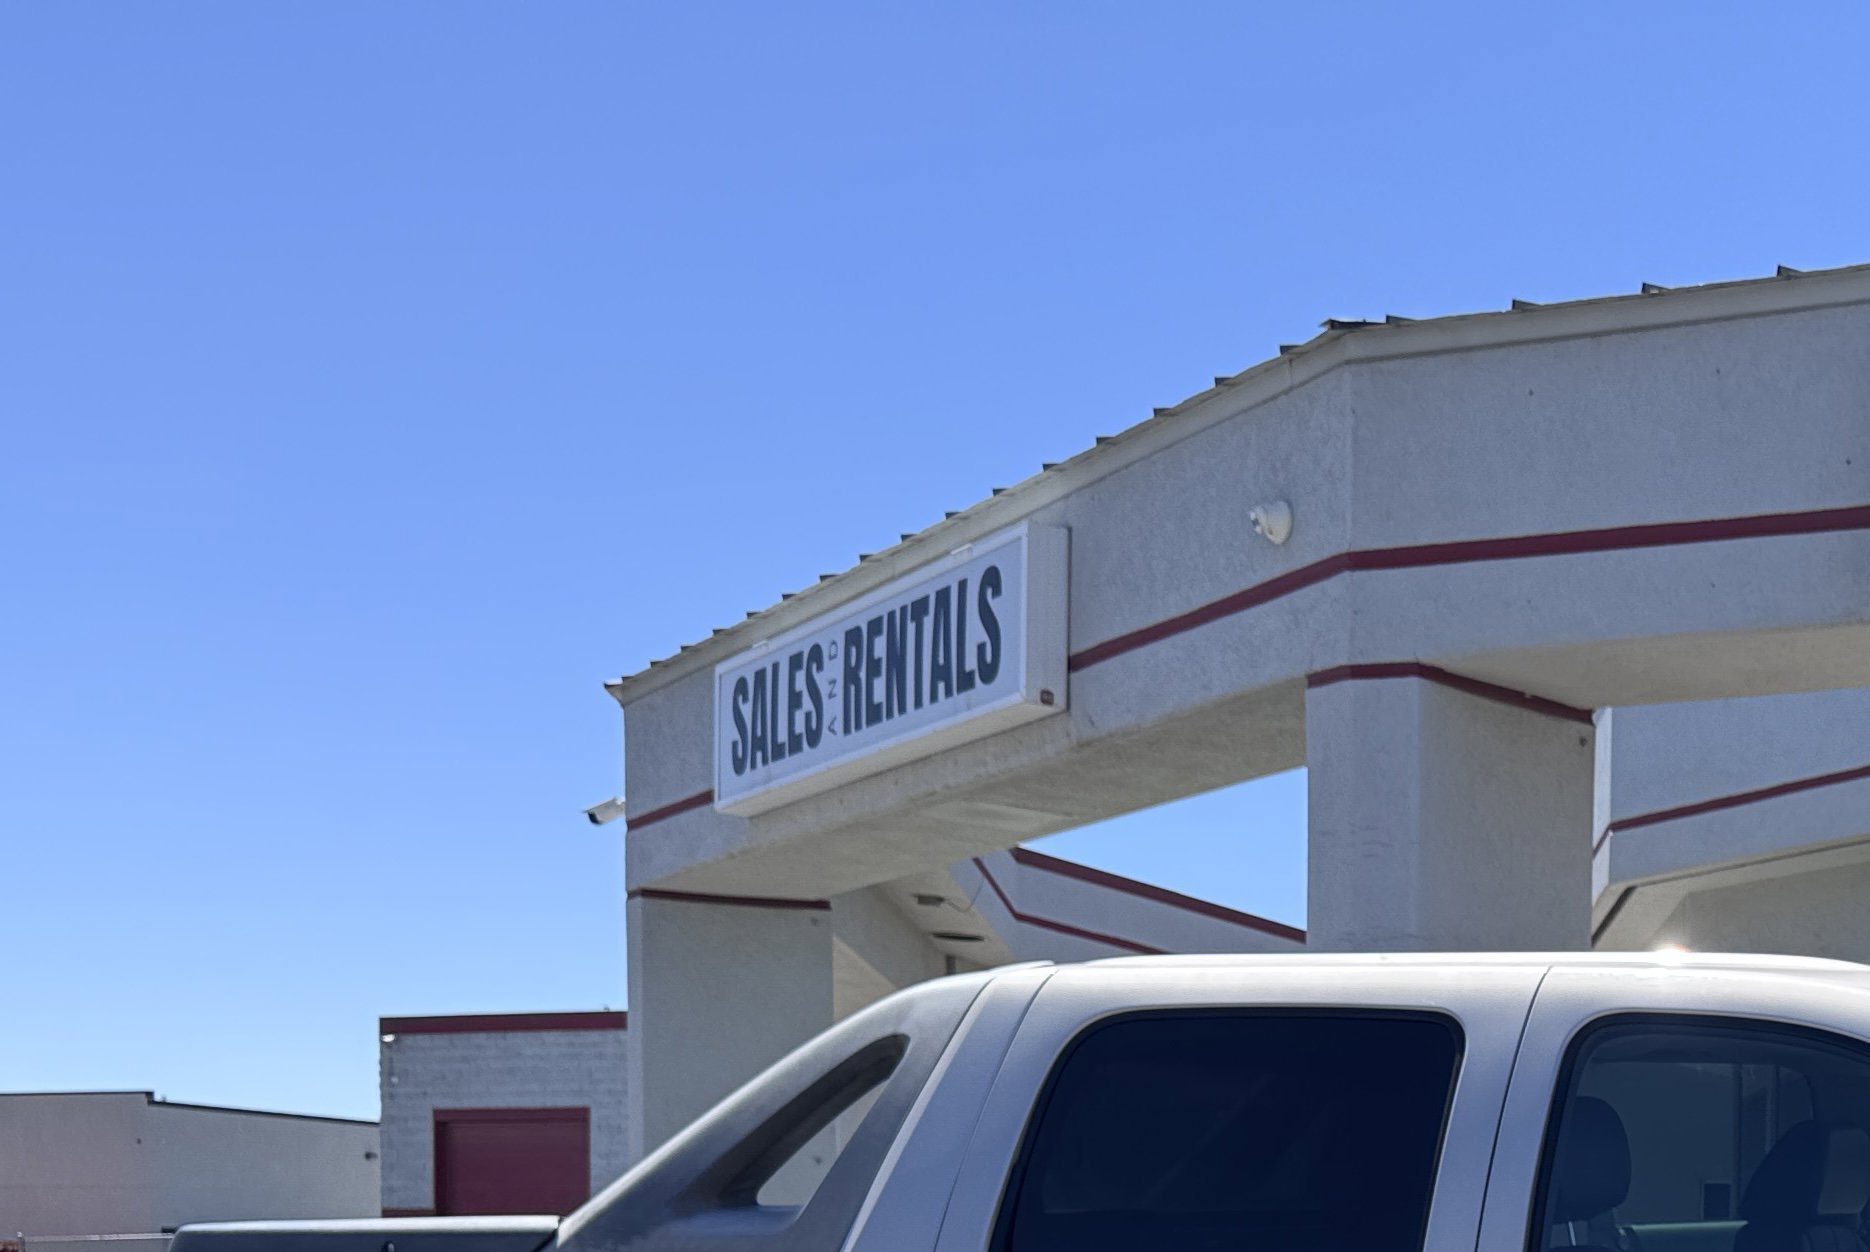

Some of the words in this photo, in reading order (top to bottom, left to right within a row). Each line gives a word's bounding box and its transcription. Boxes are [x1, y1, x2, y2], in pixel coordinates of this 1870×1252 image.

[731, 643, 824, 776] SALES
[827, 640, 839, 736] AND
[842, 565, 1002, 736] RENTALS
